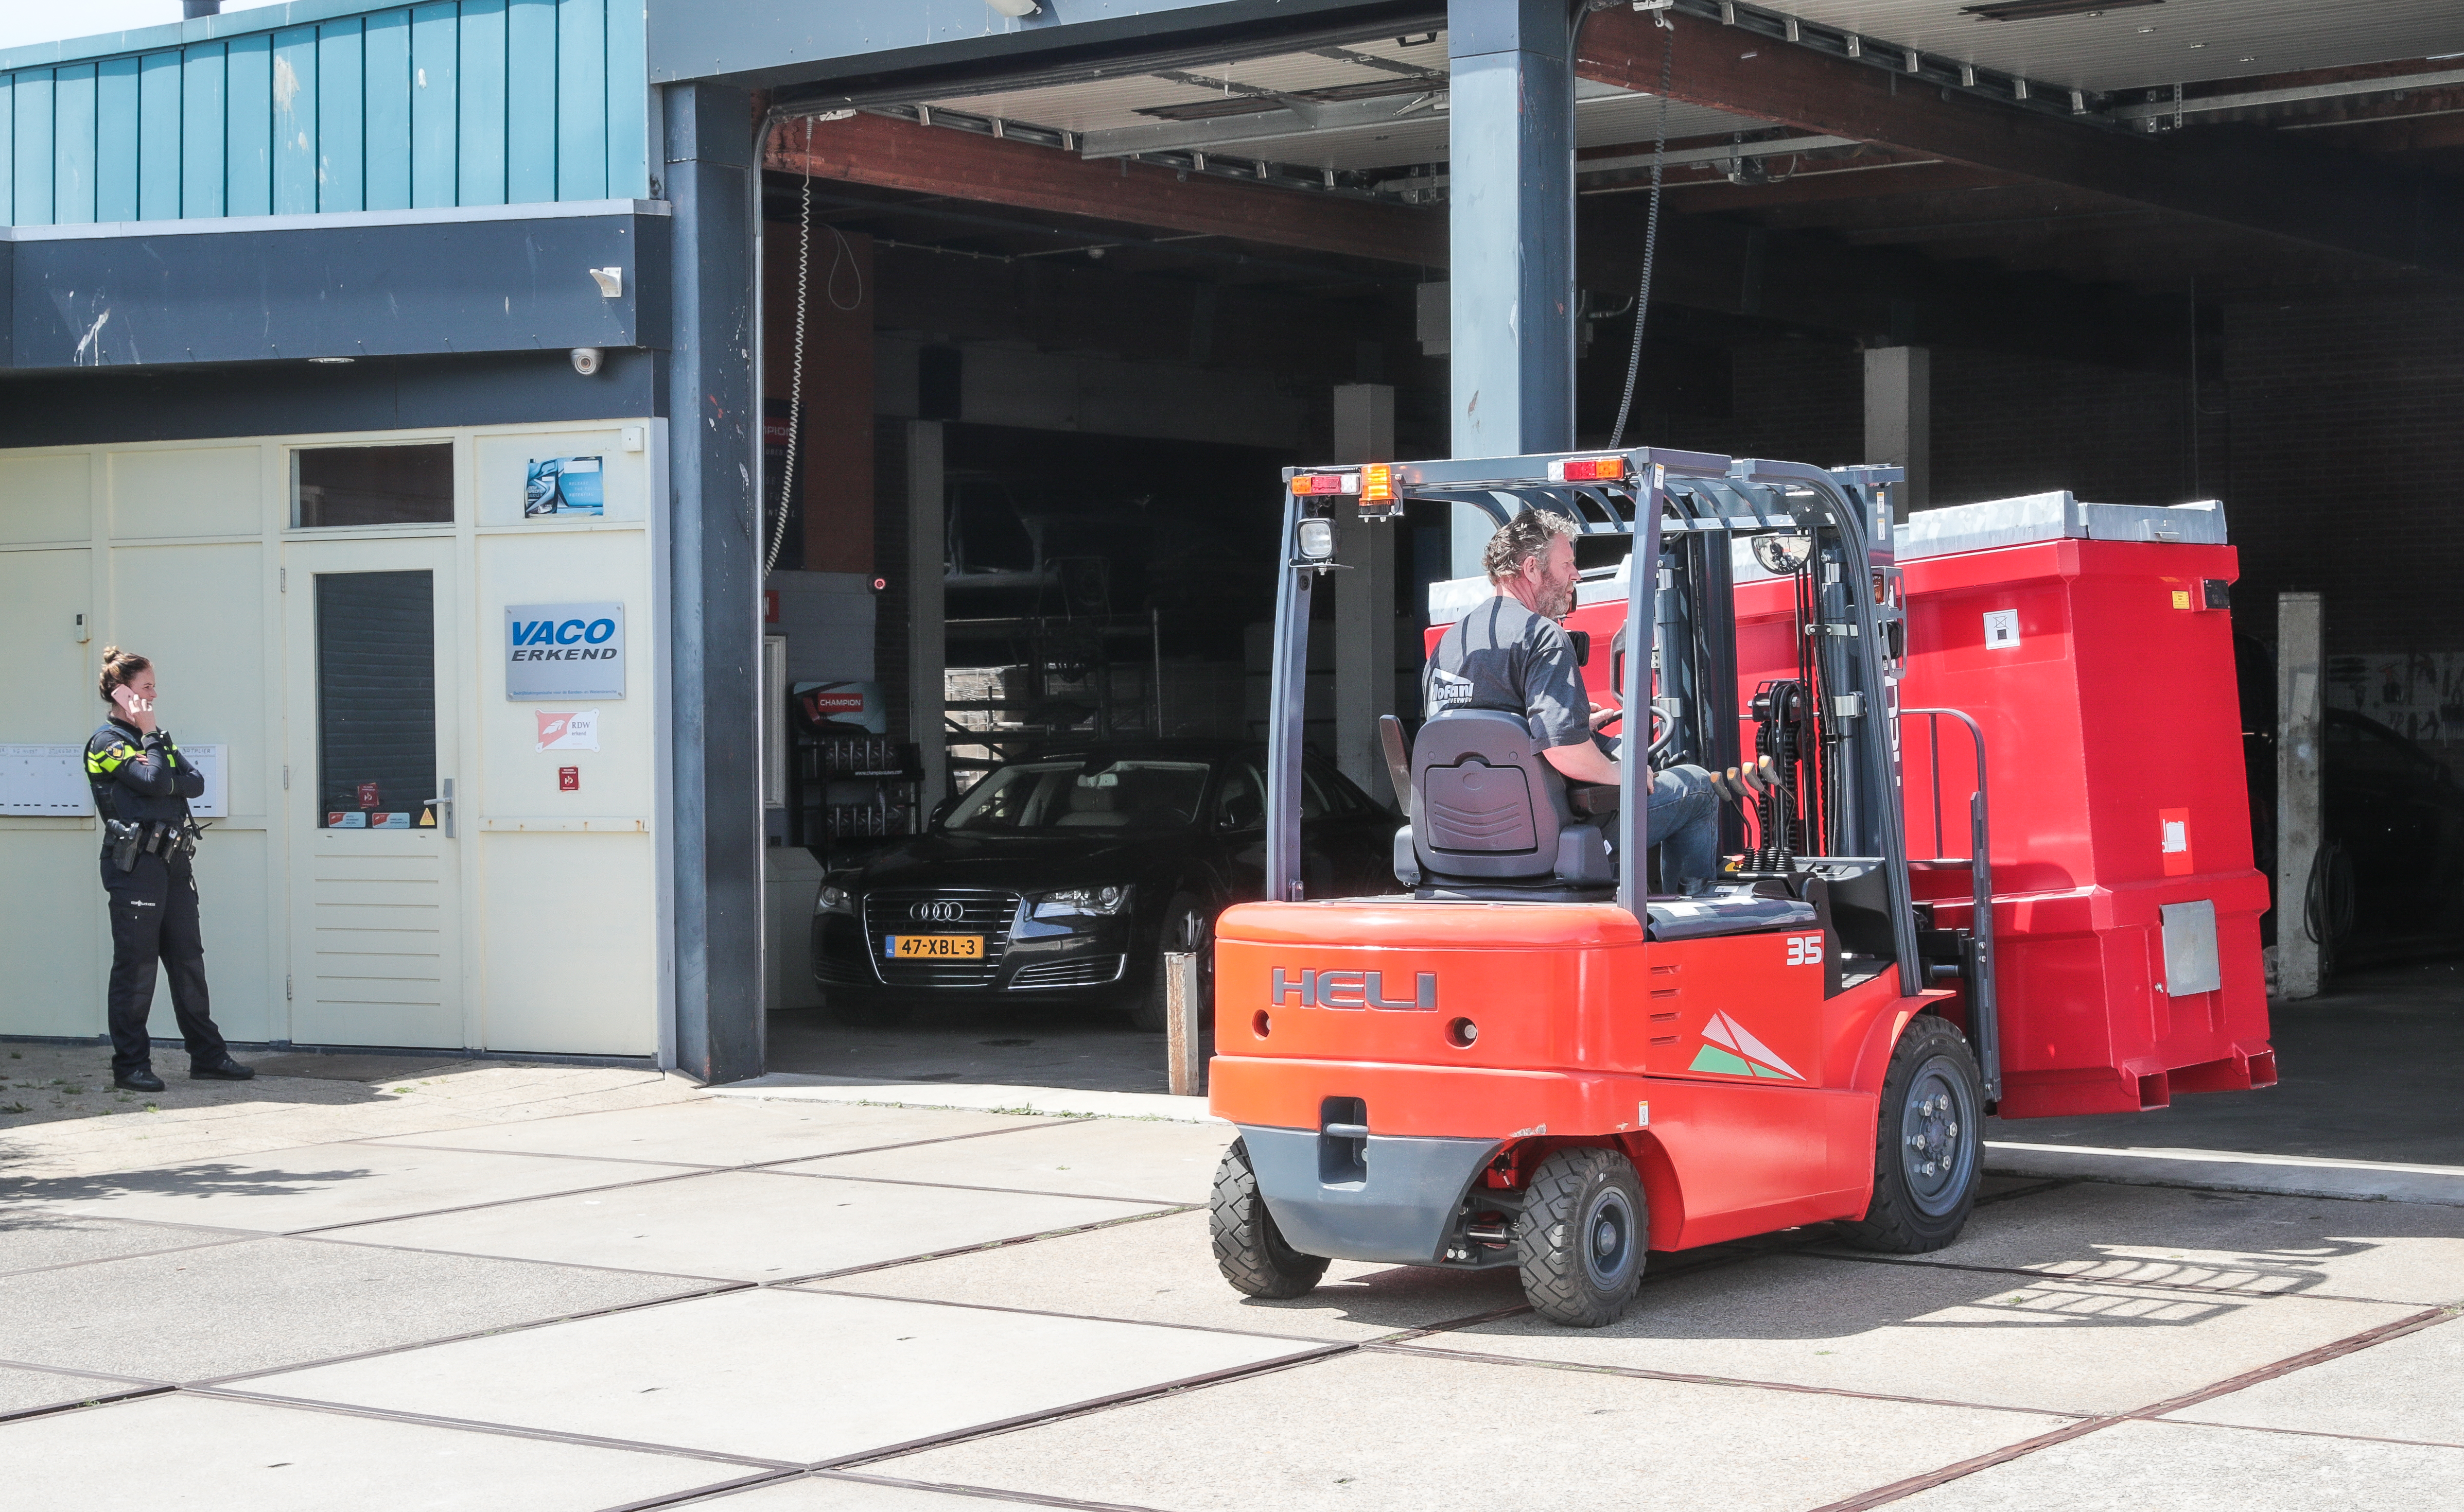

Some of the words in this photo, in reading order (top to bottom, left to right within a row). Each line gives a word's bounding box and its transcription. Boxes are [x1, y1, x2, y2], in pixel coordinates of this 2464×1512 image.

[512, 618, 615, 646] VACO
[511, 648, 617, 662] ERKEND
[902, 939, 975, 955] 47-XBL-3
[1787, 936, 1822, 965] 35
[1272, 967, 1438, 1012] HELI
